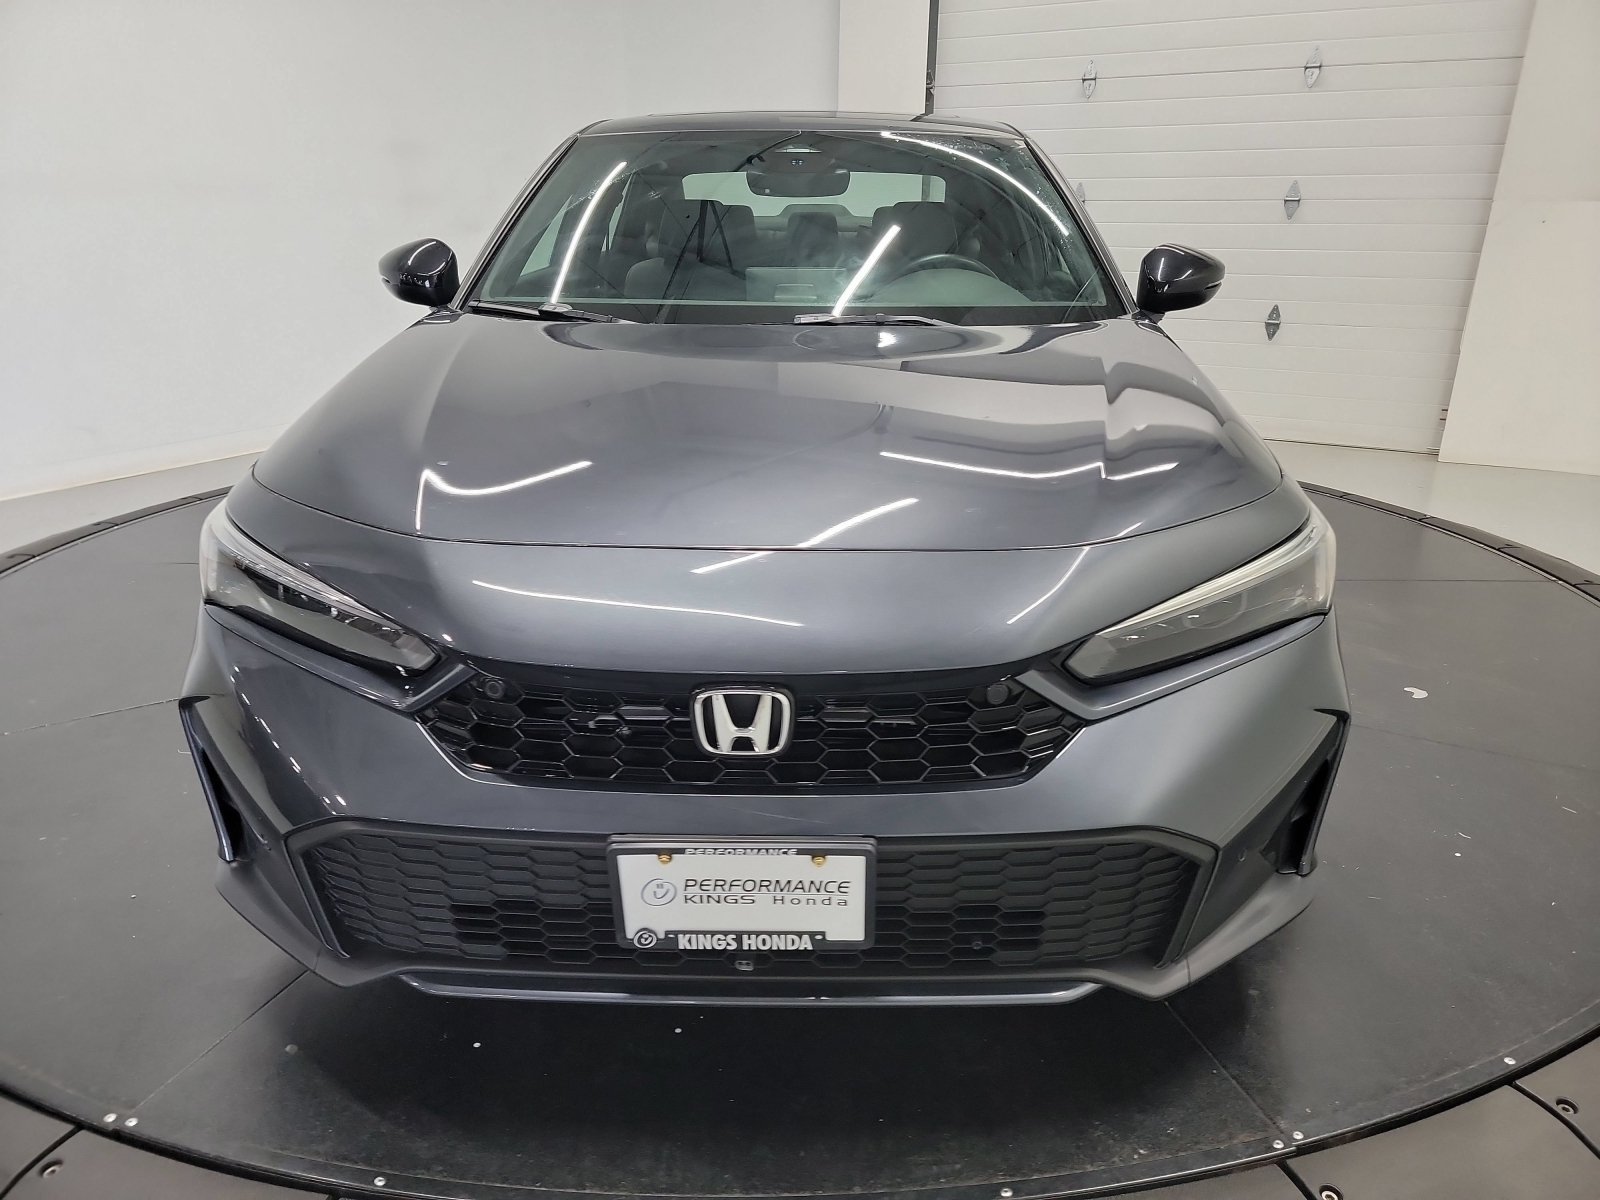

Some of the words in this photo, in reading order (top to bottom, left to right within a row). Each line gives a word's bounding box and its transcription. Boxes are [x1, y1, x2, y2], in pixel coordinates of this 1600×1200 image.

[684, 848, 798, 856] PERFORMANCE
[684, 878, 851, 894] PERFORMANCE
[684, 895, 755, 905] KINGS
[774, 895, 849, 906] Honda
[678, 934, 737, 950] KINGS
[742, 934, 813, 950] HONDA
